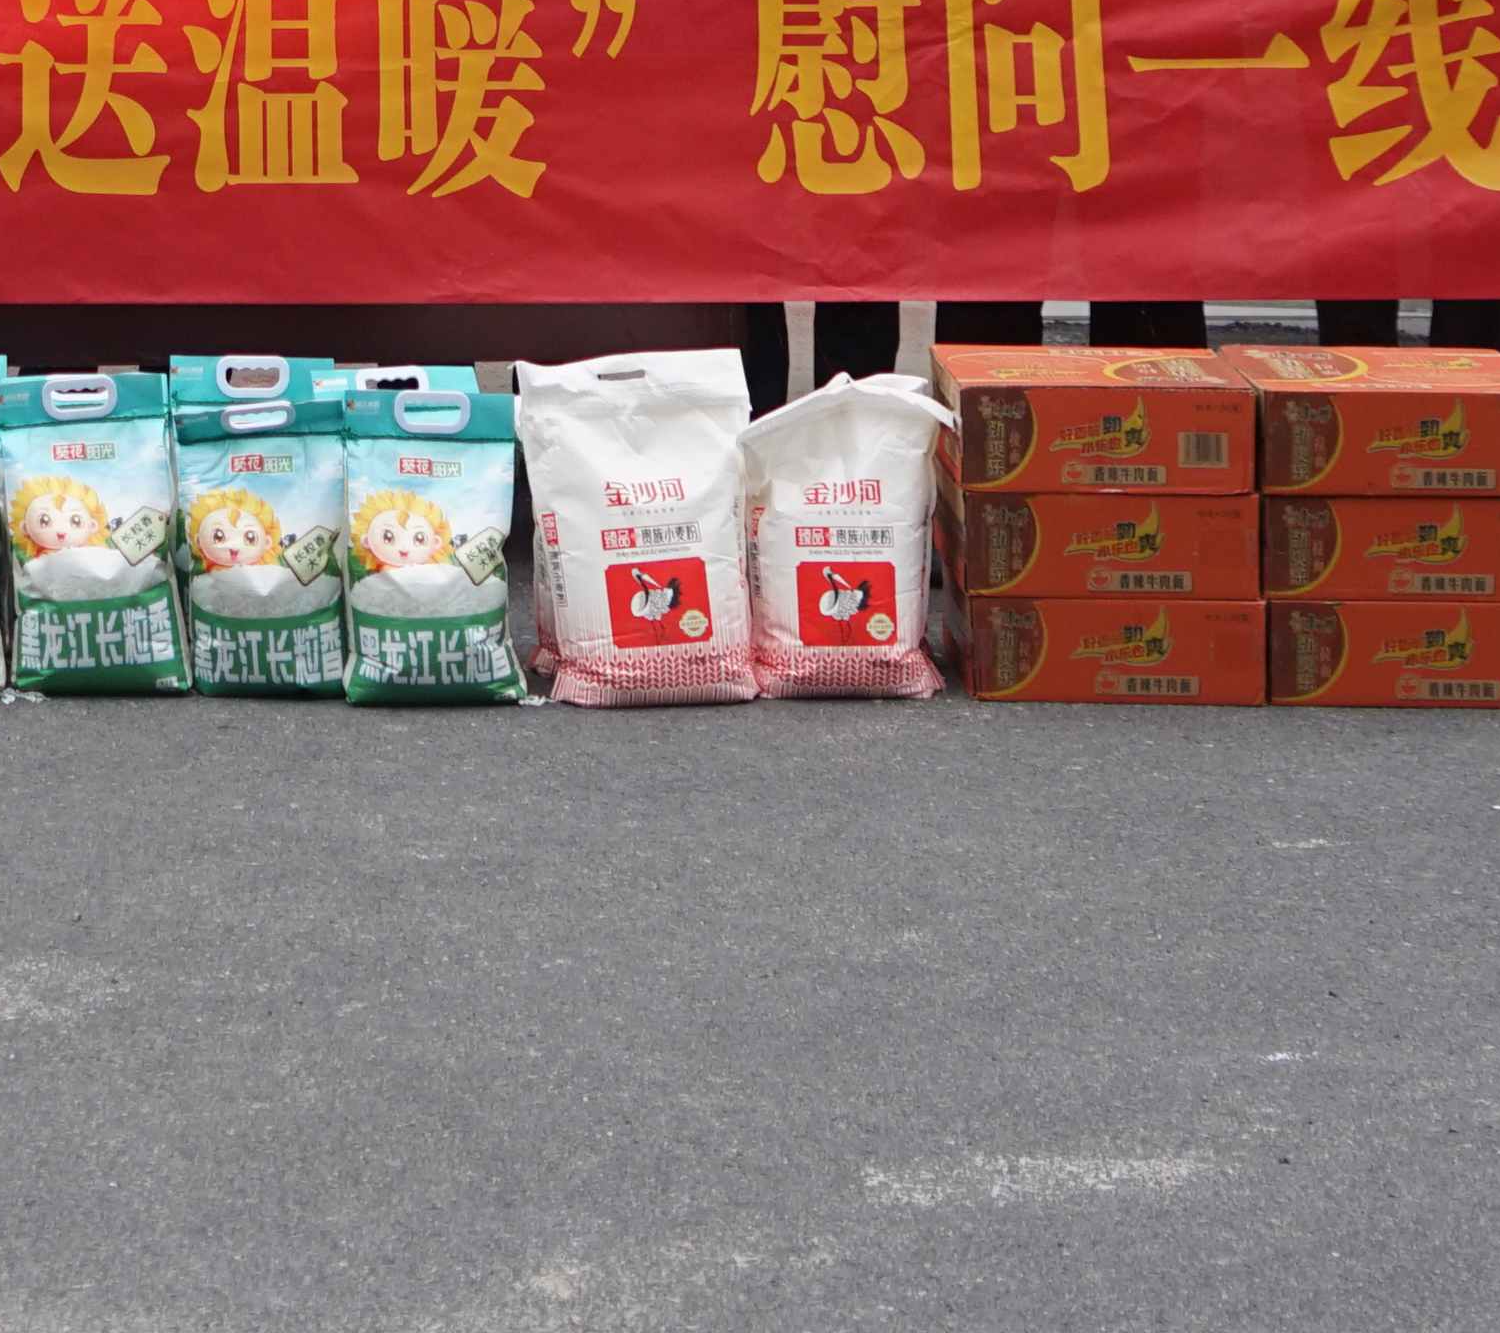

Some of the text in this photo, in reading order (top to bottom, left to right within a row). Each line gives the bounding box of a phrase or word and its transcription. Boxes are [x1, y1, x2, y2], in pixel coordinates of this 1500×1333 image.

[604, 478, 686, 507] 金沙河
[803, 479, 882, 506] 金沙河
[20, 596, 175, 671] 黑龙江长粒香
[193, 616, 344, 685] 黑龙江长粒香
